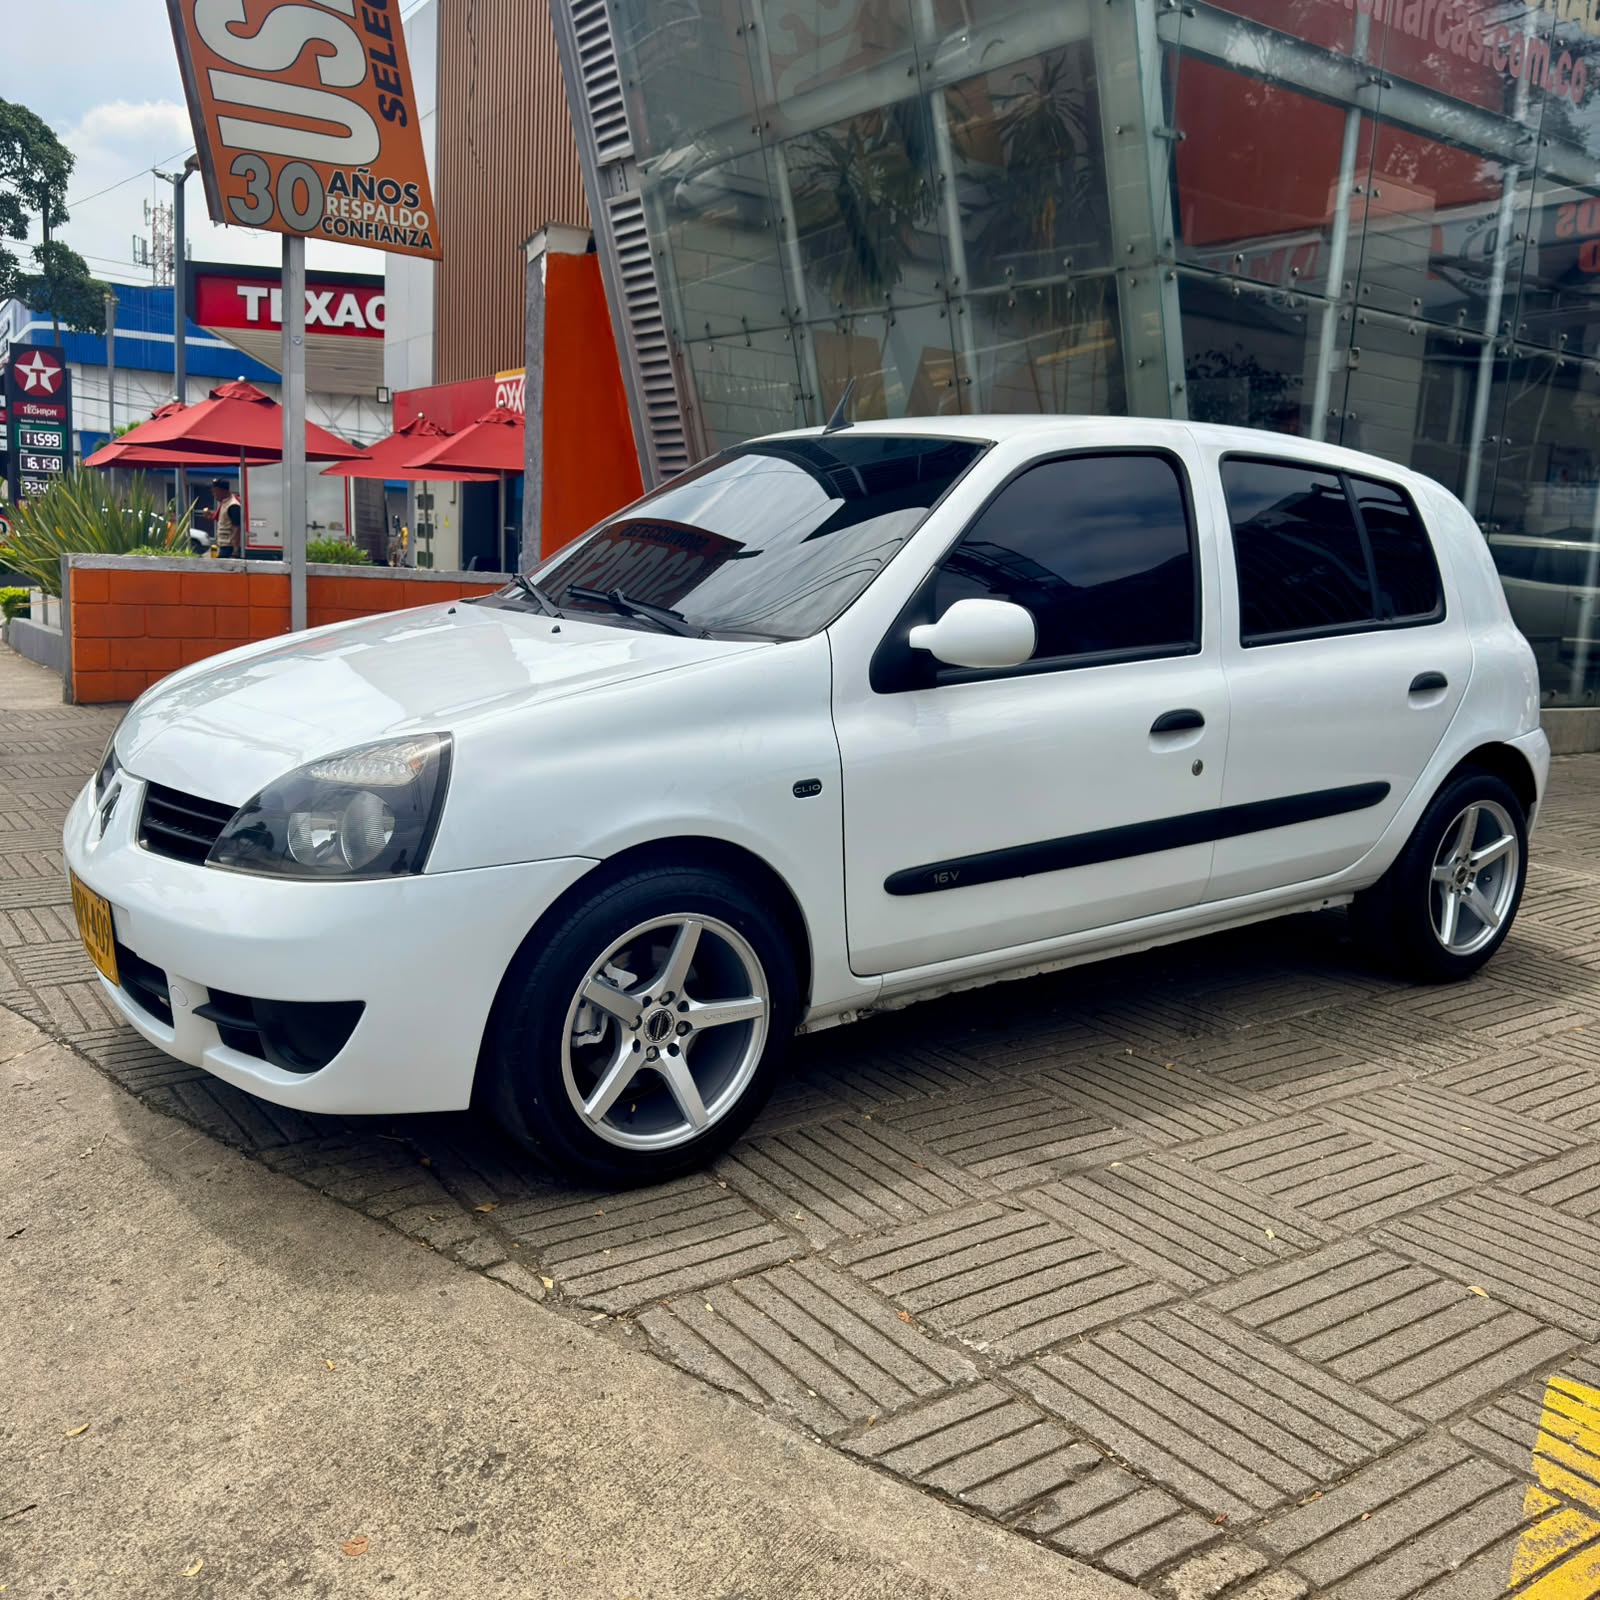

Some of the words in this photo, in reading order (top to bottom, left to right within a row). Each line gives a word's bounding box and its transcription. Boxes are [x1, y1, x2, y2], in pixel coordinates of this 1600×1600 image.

[227, 153, 324, 232] 30
[327, 168, 420, 208] AÑOS
[326, 196, 429, 230] RESPALDO
[321, 216, 433, 249] CONFIANZA
[794, 784, 821, 794] CLIO
[934, 871, 960, 883] 16V
